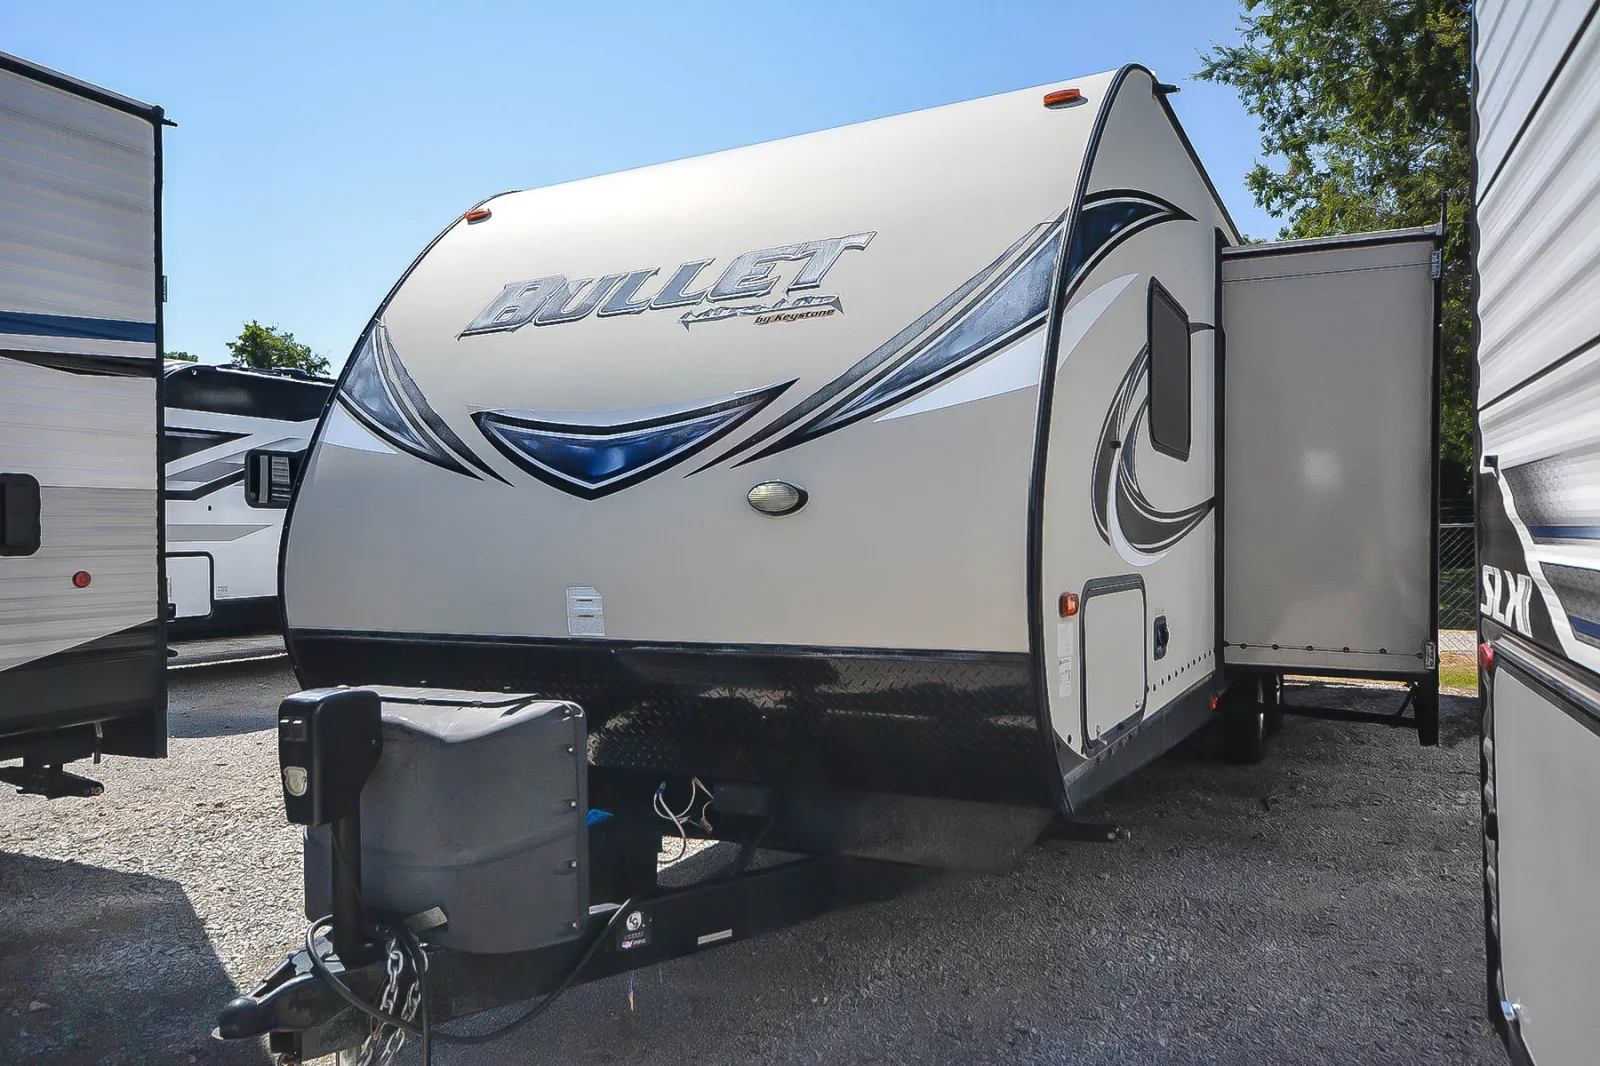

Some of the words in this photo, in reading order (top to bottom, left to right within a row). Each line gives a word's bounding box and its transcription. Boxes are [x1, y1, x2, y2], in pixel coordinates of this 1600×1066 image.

[454, 231, 878, 341] BULLET
[755, 314, 772, 326] by
[774, 310, 835, 322] Keystone
[1480, 564, 1532, 638] SLX
